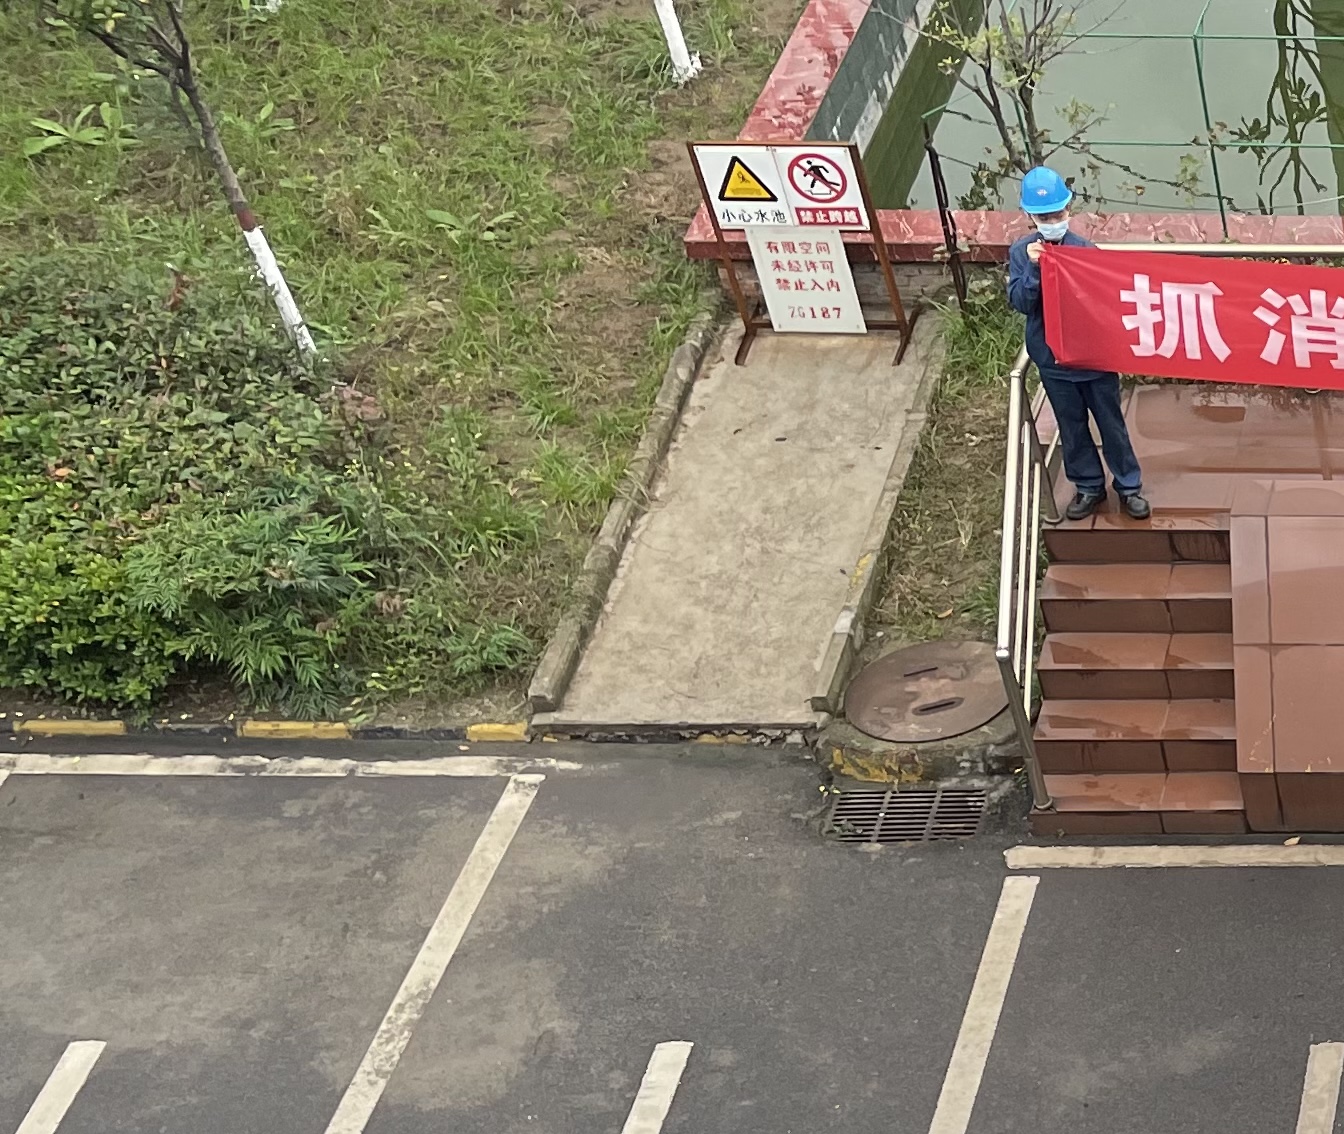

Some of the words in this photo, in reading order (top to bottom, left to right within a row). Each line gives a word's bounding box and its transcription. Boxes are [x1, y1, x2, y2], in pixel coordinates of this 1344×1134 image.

[721, 208, 787, 223] 小心水池
[799, 209, 859, 223] 禁止跨越
[764, 241, 831, 254] 有限空间
[771, 259, 835, 273] 未经许可
[776, 278, 841, 292] 禁止入内
